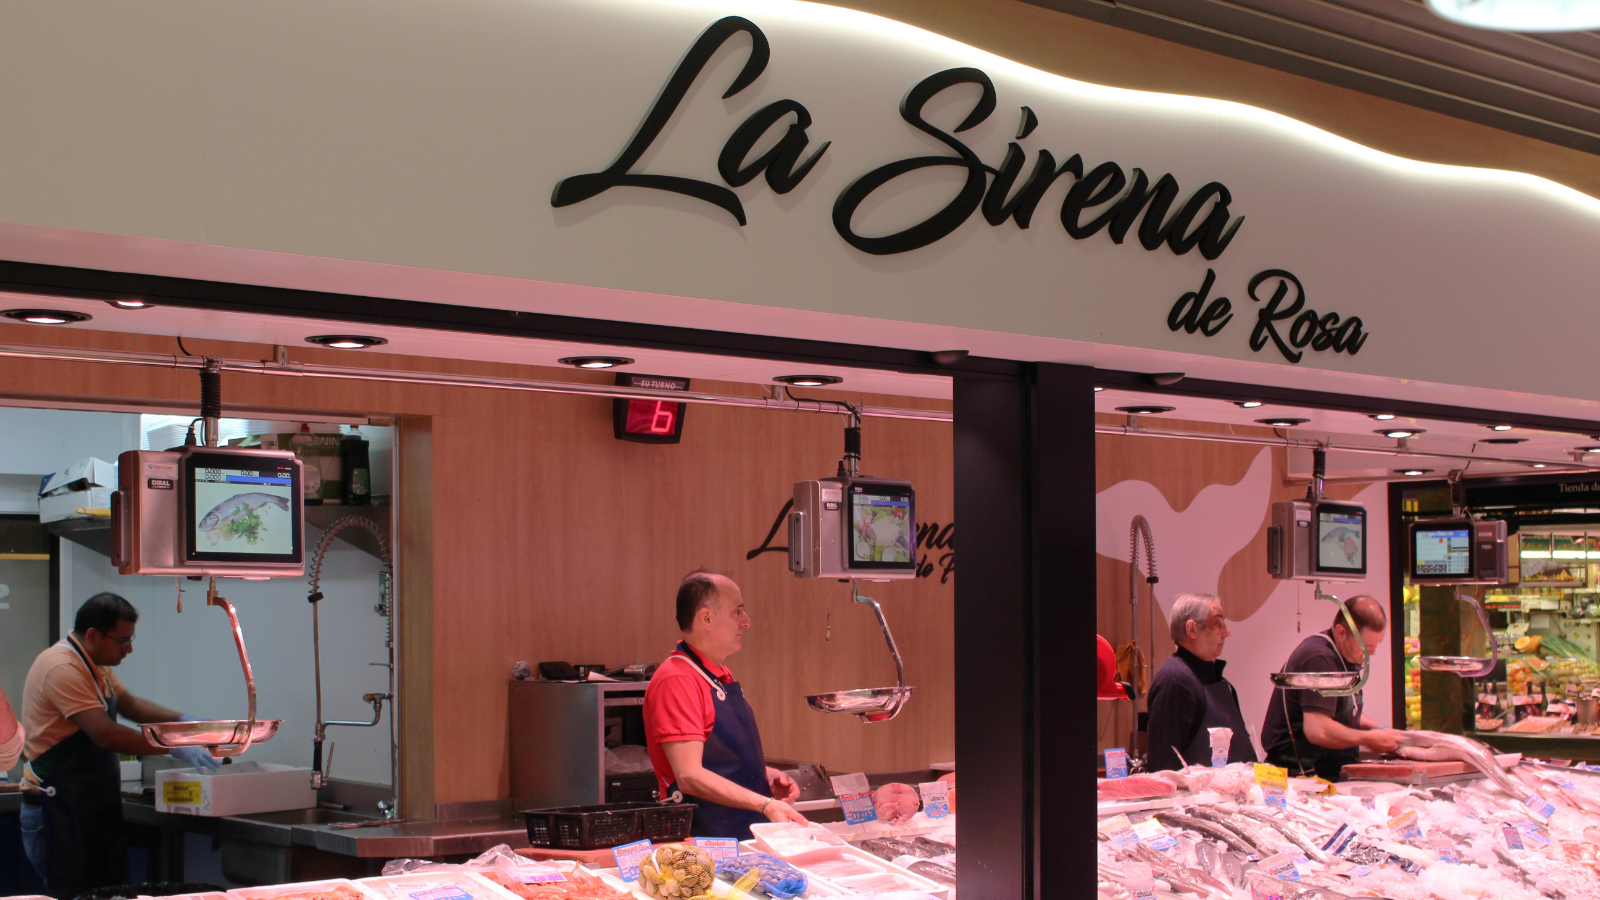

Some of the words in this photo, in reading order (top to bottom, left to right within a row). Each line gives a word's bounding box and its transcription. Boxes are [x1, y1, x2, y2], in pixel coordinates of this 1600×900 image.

[551, 15, 832, 227] La
[832, 66, 1246, 260] Sirena
[1167, 268, 1234, 337] de
[1247, 268, 1369, 363] Rosa
[651, 381, 676, 389] TURNO
[651, 400, 673, 433] 6
[151, 479, 171, 487] DIBAL
[1559, 482, 1589, 492] Tienda
